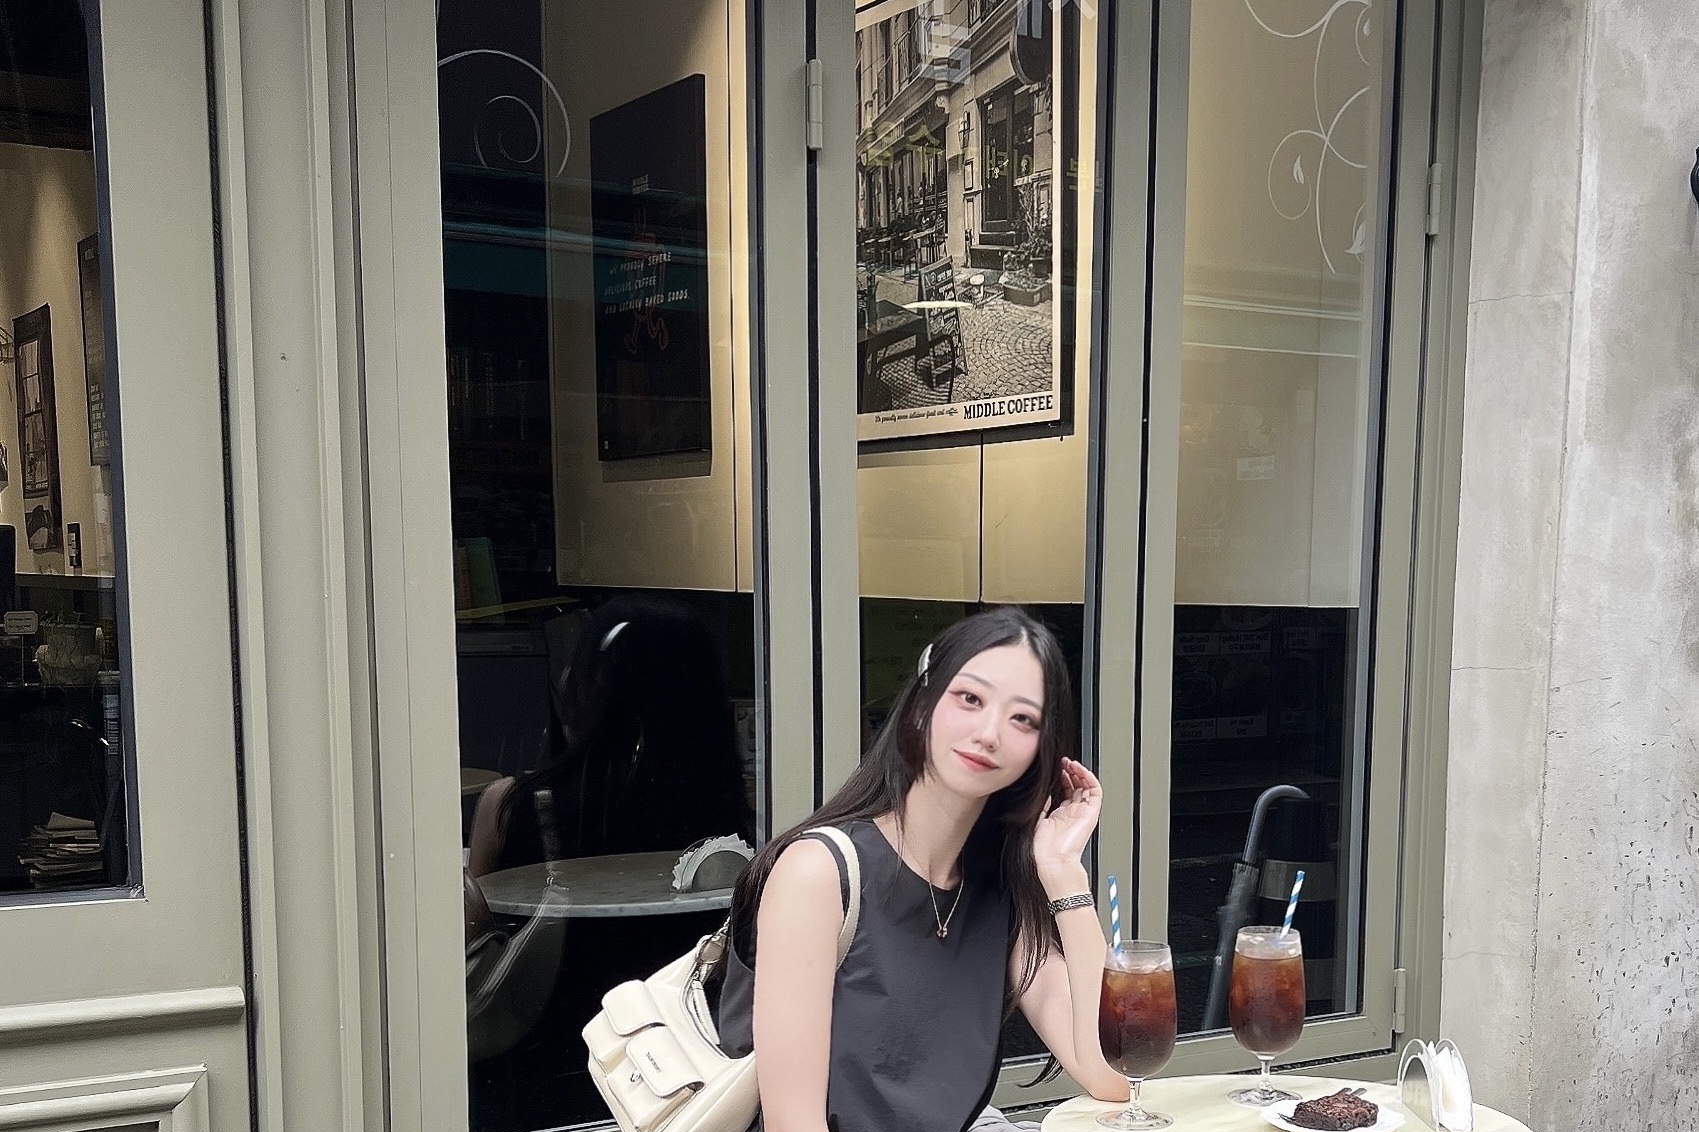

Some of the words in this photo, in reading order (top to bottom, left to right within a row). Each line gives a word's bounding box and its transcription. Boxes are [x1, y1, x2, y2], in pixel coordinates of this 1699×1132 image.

[635, 276, 657, 290] COFFEE
[645, 293, 665, 307] BAKED
[963, 400, 1006, 420] MIDDLE
[1007, 395, 1053, 415] COFFEE
